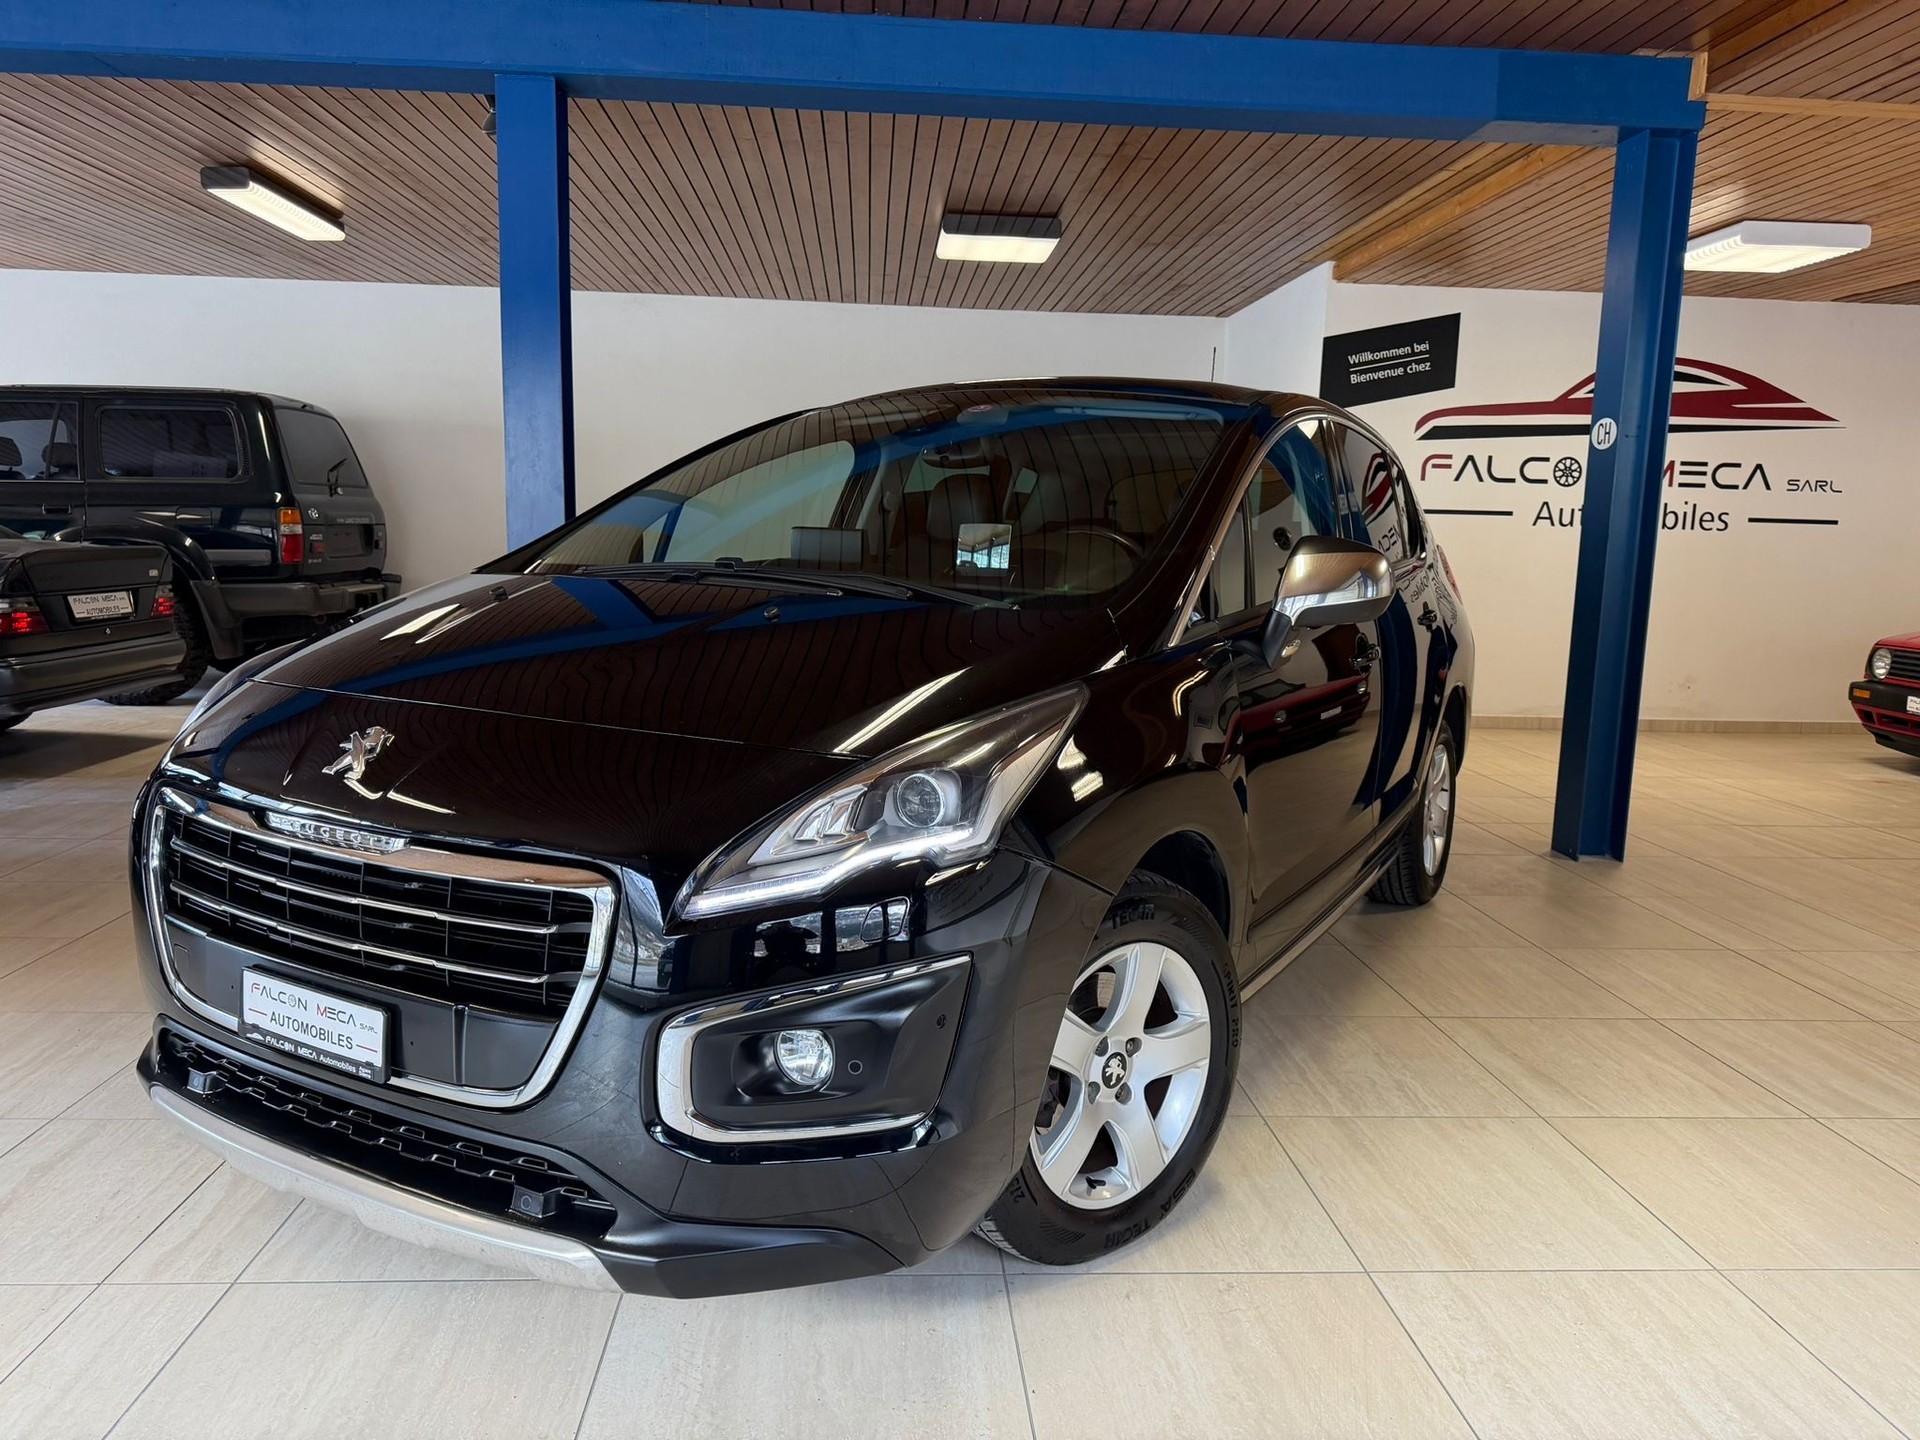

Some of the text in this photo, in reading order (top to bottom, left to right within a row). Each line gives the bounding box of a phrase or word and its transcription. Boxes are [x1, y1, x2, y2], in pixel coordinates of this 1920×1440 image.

[1348, 340, 1429, 365] Willkommen bei
[1350, 361, 1431, 384] Bienvenue chez
[1596, 422, 1611, 446] CH
[1420, 453, 1583, 488] FALCO
[1786, 479, 1842, 493] SARL
[251, 982, 308, 1012] FALCON
[316, 1003, 357, 1027] MECA
[270, 1011, 353, 1050] AUTOMOBILES
[265, 1035, 295, 1053] FALCON
[297, 1046, 318, 1060] MECA
[319, 1053, 357, 1073] Automobiles
